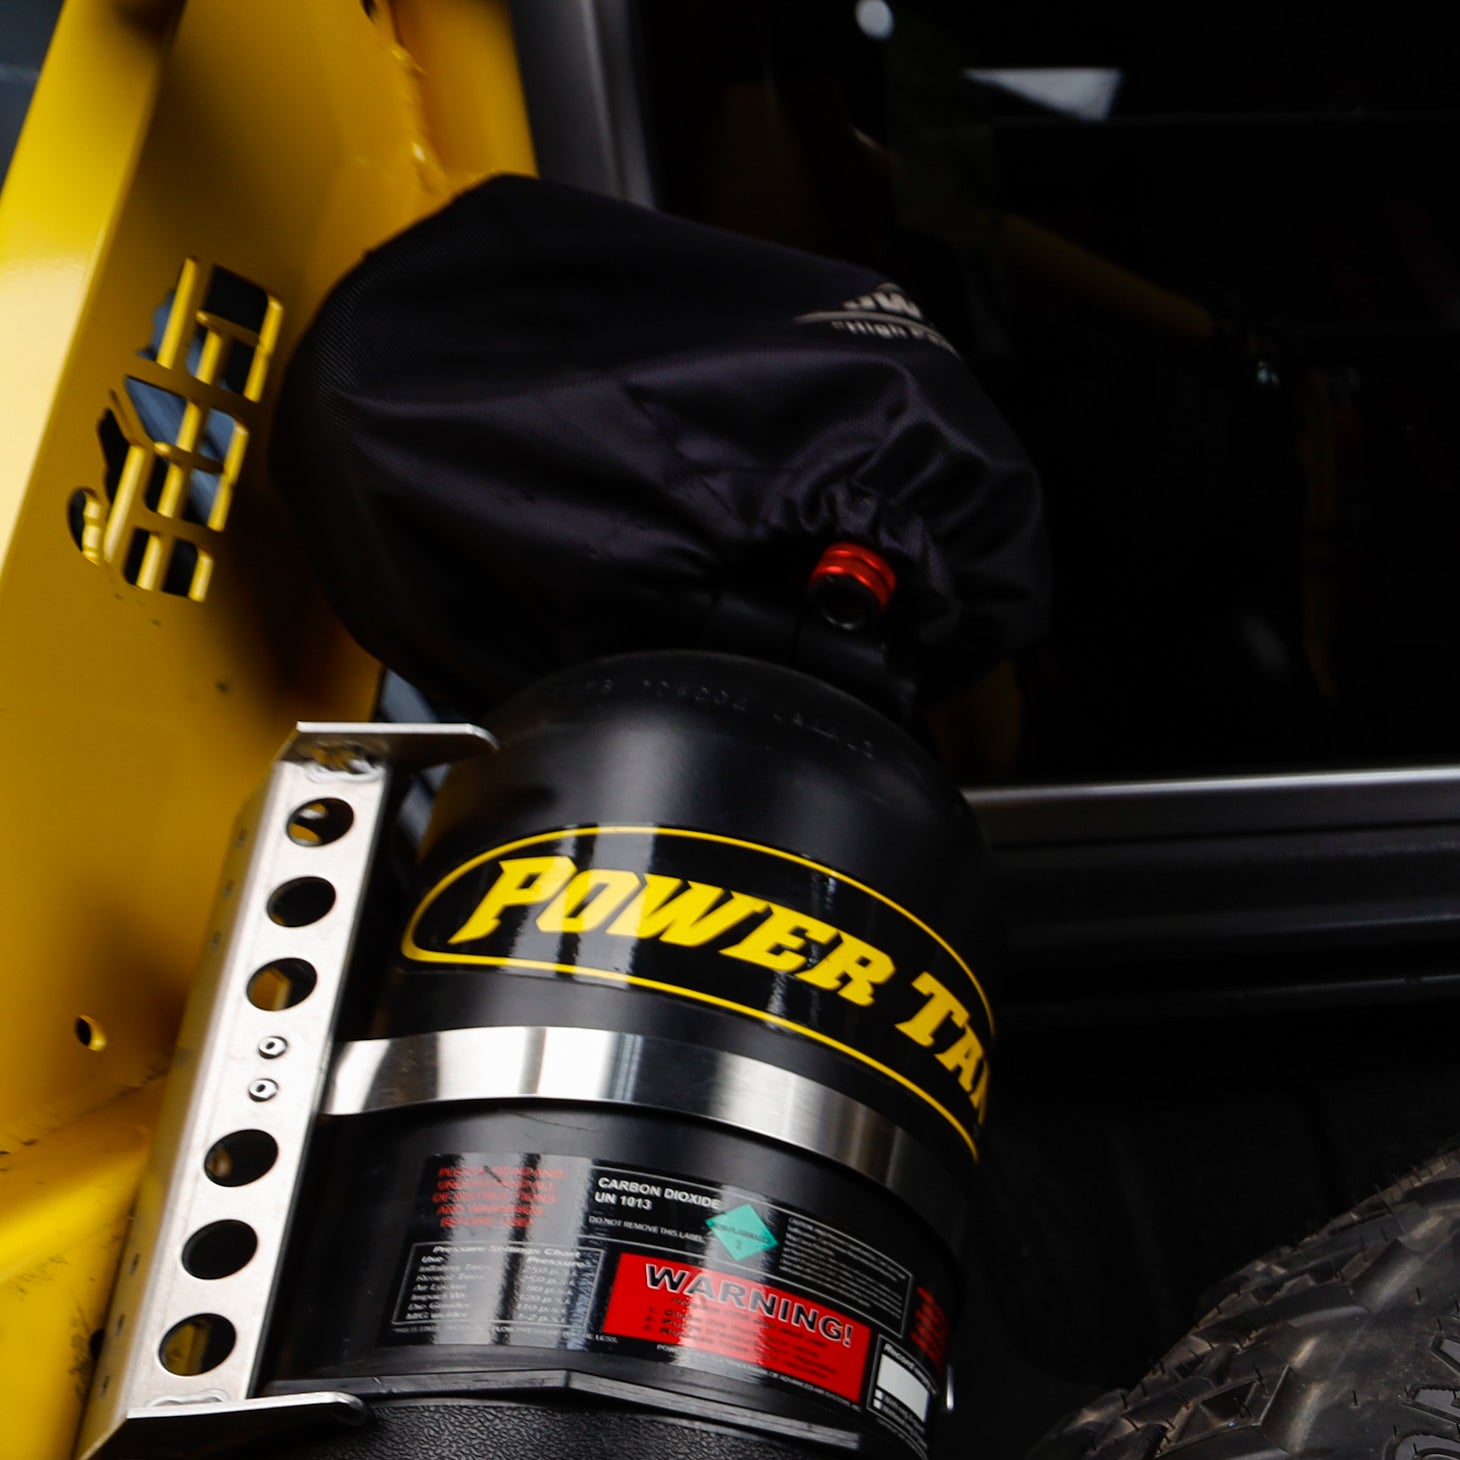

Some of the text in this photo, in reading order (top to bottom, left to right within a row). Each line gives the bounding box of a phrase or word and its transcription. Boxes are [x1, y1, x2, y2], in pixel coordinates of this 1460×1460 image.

[447, 856, 896, 1008] POWER
[594, 1191, 653, 1211] UN 1013
[598, 1177, 724, 1211] CARBON DIOXIDE
[645, 1263, 855, 1349] WARNING!
